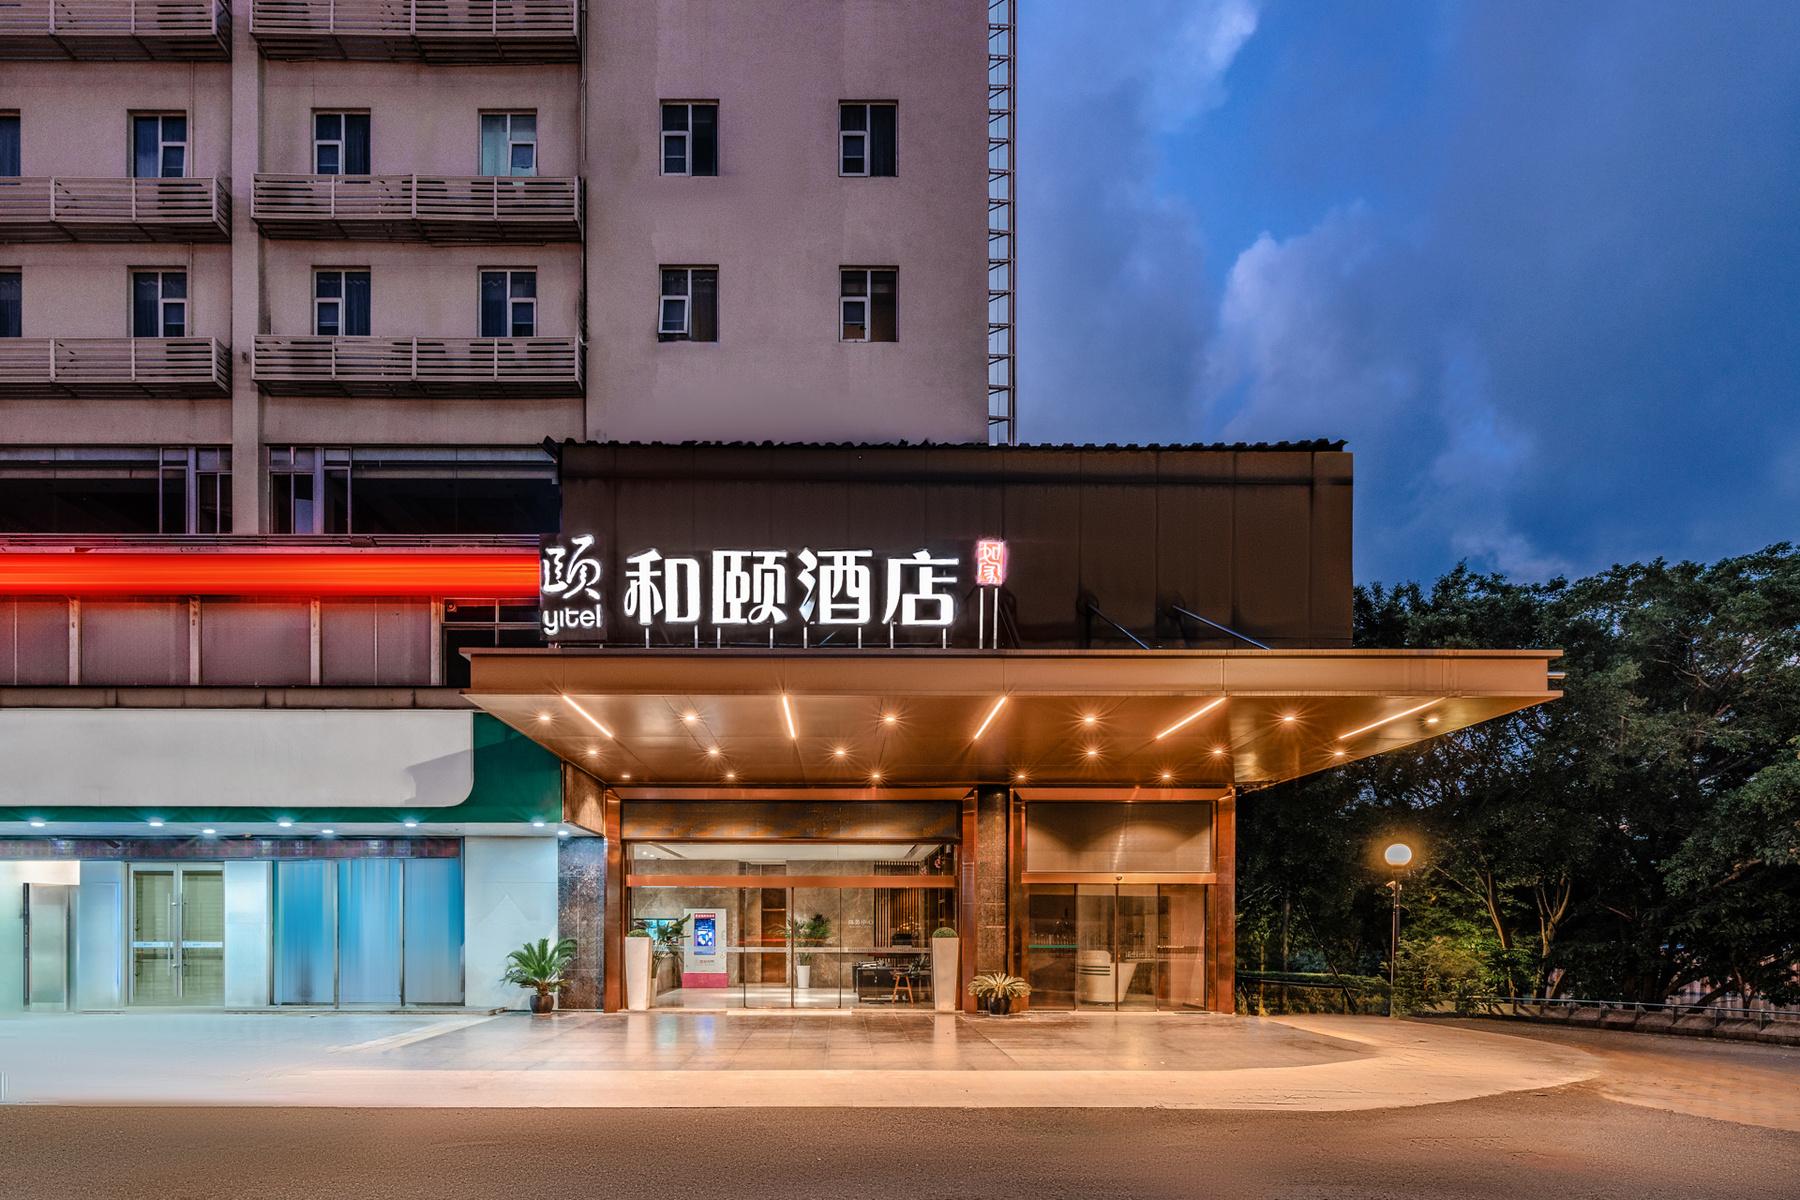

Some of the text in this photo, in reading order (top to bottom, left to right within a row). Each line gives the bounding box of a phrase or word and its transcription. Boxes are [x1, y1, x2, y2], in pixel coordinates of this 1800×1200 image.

[542, 534, 601, 600] 颐
[624, 548, 960, 625] 和颐酒店
[978, 542, 1003, 584] 如家
[542, 604, 602, 636] yitel
